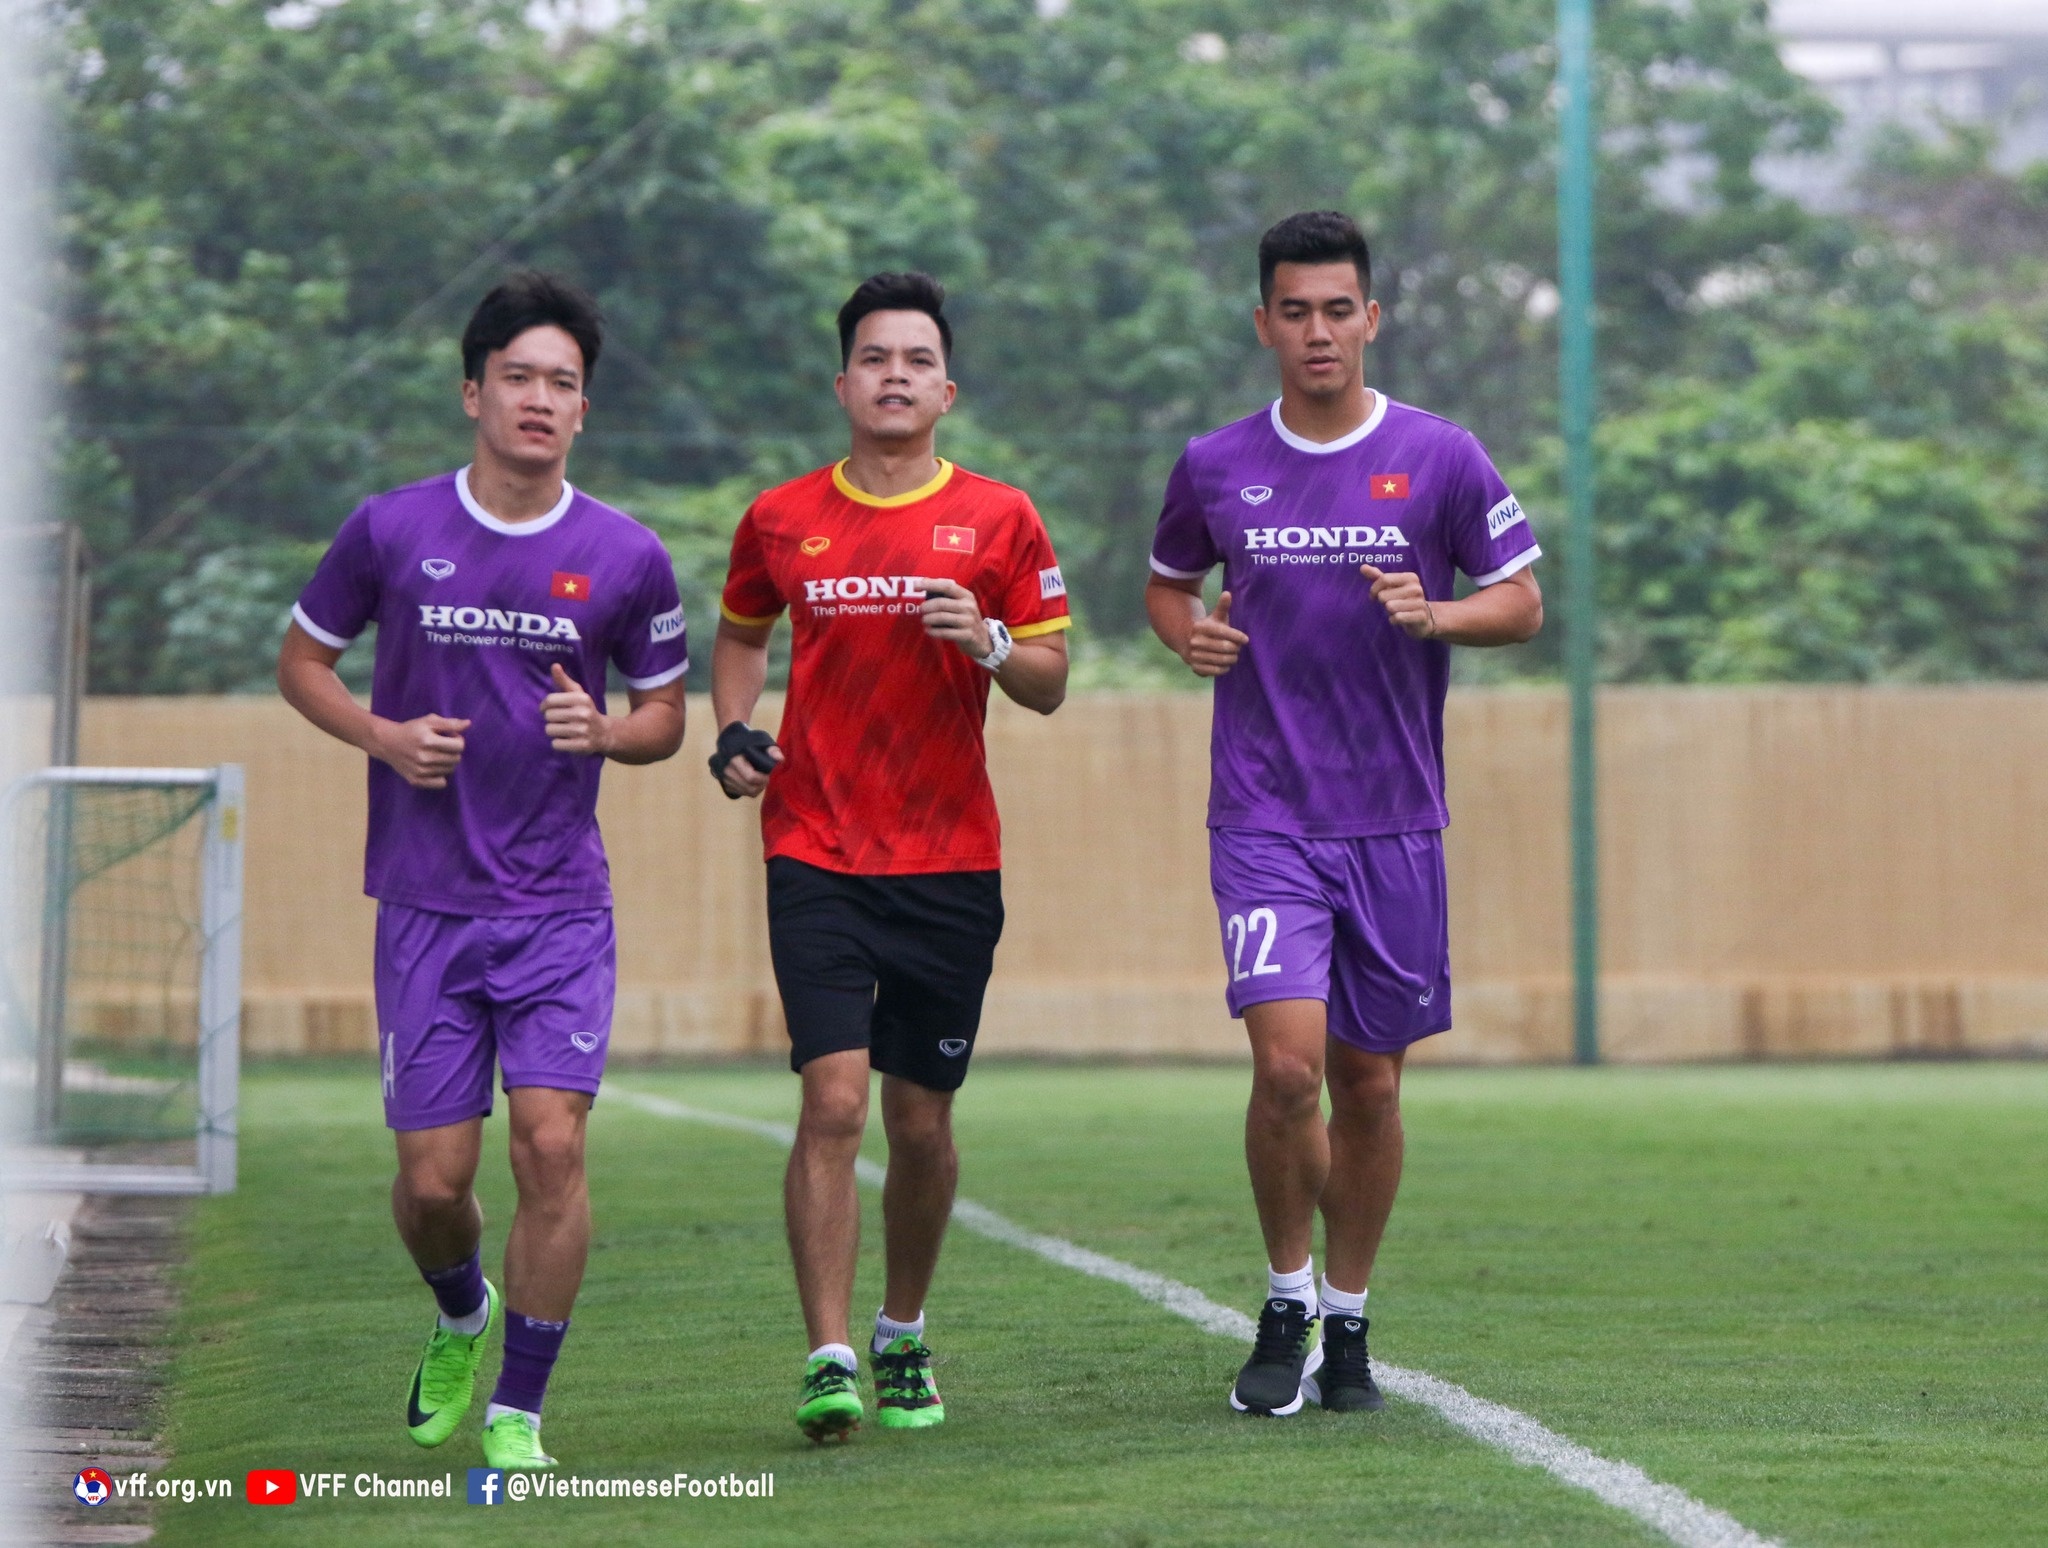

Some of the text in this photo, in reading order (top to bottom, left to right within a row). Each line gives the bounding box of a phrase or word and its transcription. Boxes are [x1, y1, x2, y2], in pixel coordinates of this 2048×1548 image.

[1244, 525, 1410, 550] HONDA
[1251, 551, 1404, 565] The Power of Dreams
[812, 604, 836, 617] The
[839, 603, 884, 615] Power
[887, 602, 902, 614] of
[418, 604, 582, 641] HONDA
[425, 630, 575, 654] The Power of Dreams
[1227, 907, 1282, 982] 22
